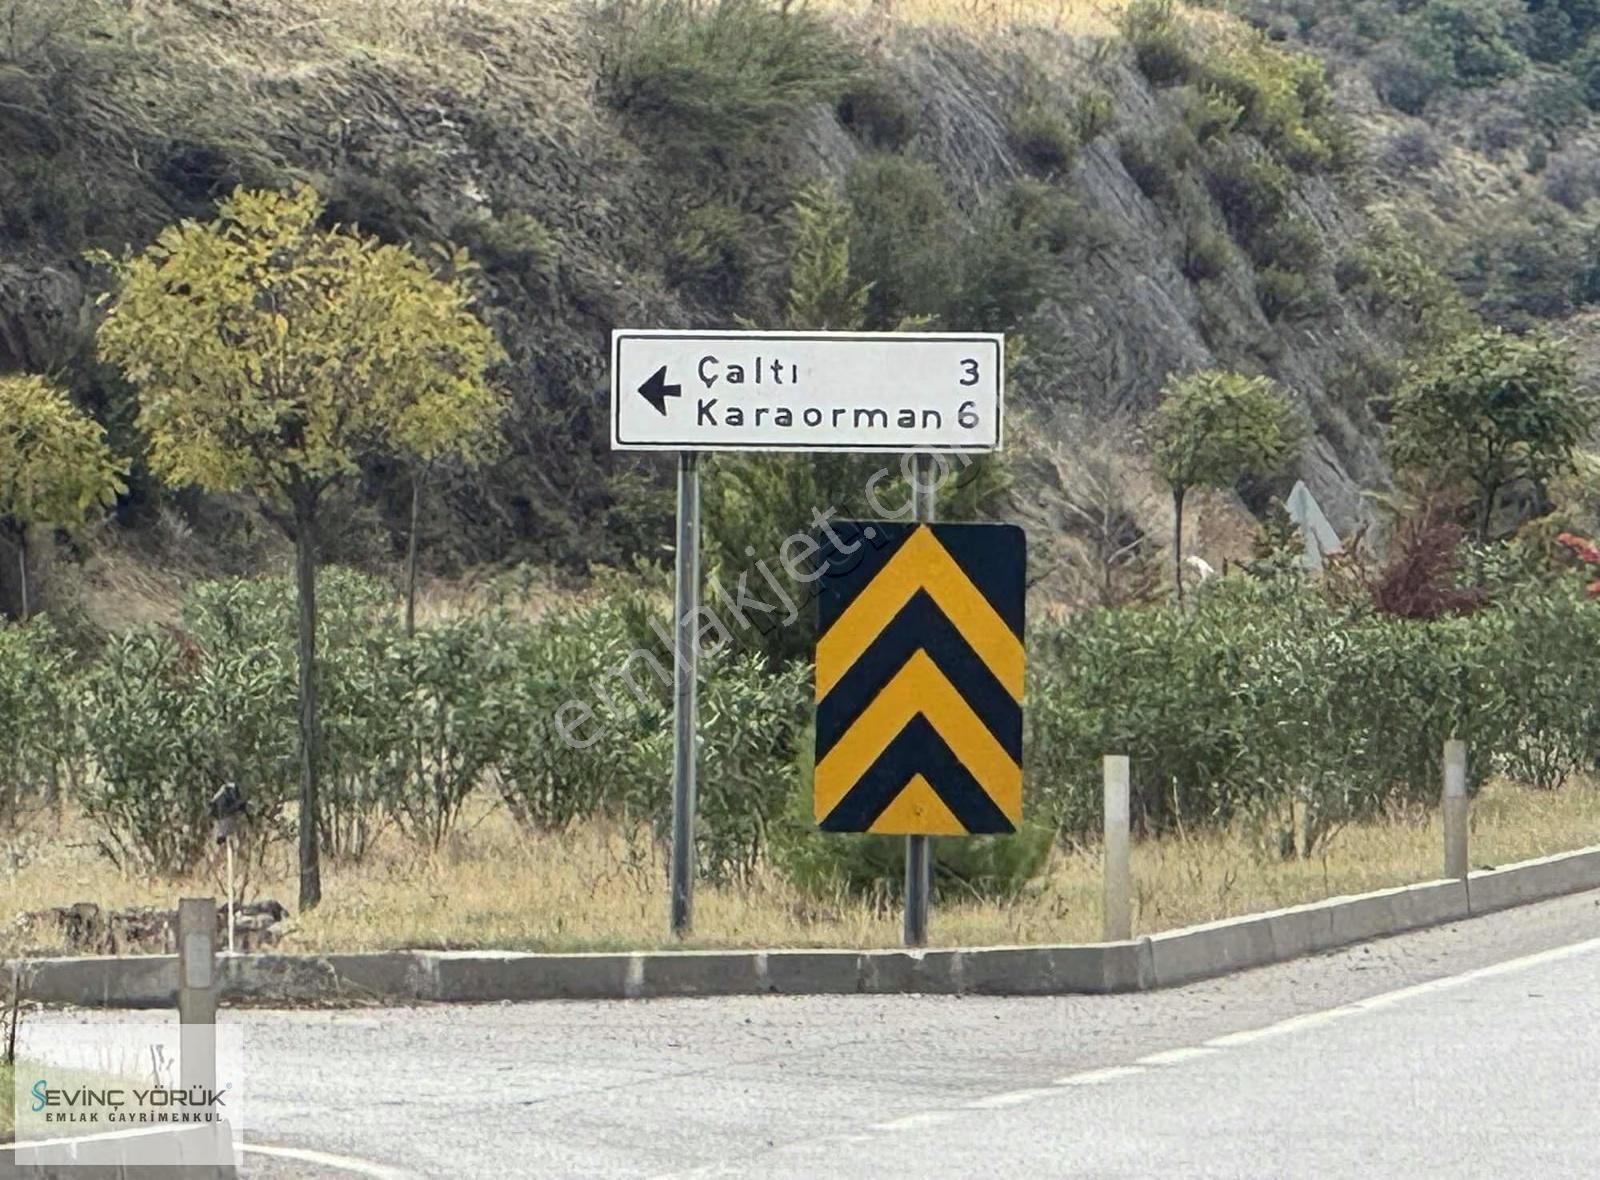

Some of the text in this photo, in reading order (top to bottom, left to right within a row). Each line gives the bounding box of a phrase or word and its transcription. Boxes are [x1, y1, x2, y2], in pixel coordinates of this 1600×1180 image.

[698, 354, 980, 388] Çaltı 3
[698, 399, 980, 428] Karaorman 6
